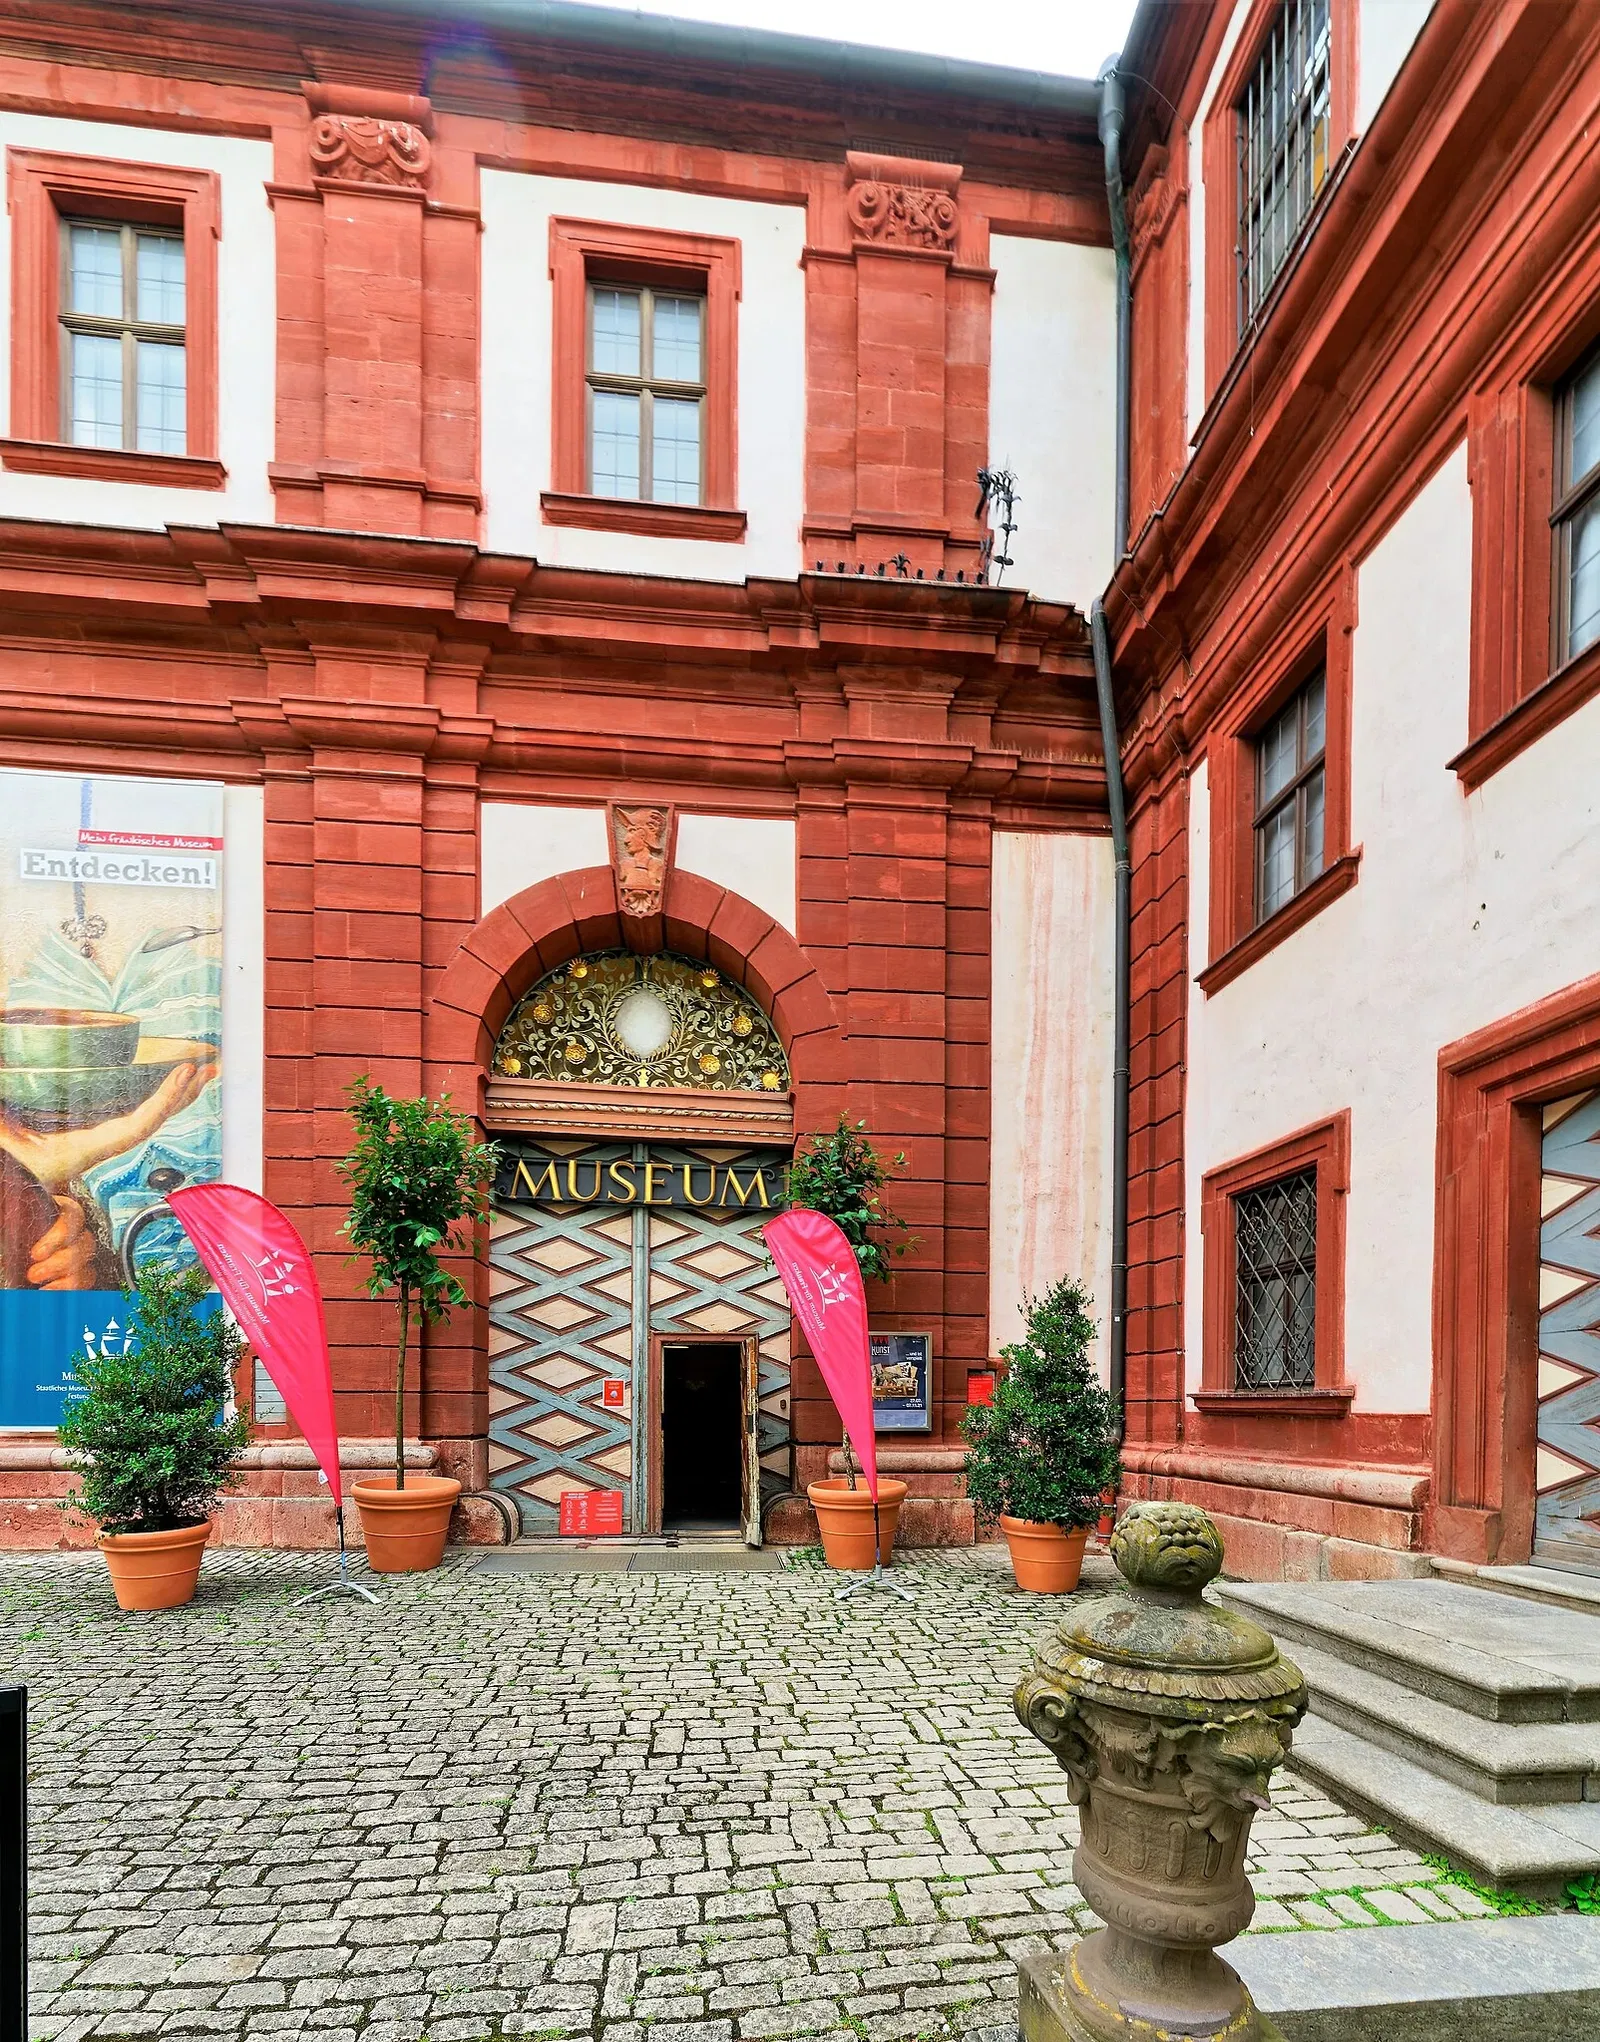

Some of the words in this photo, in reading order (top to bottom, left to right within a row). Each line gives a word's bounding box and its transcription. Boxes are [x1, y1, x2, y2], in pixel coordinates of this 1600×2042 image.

[173, 838, 214, 849] Museum
[23, 851, 213, 885] Entdecken!
[508, 1158, 772, 1209] MUSEUM
